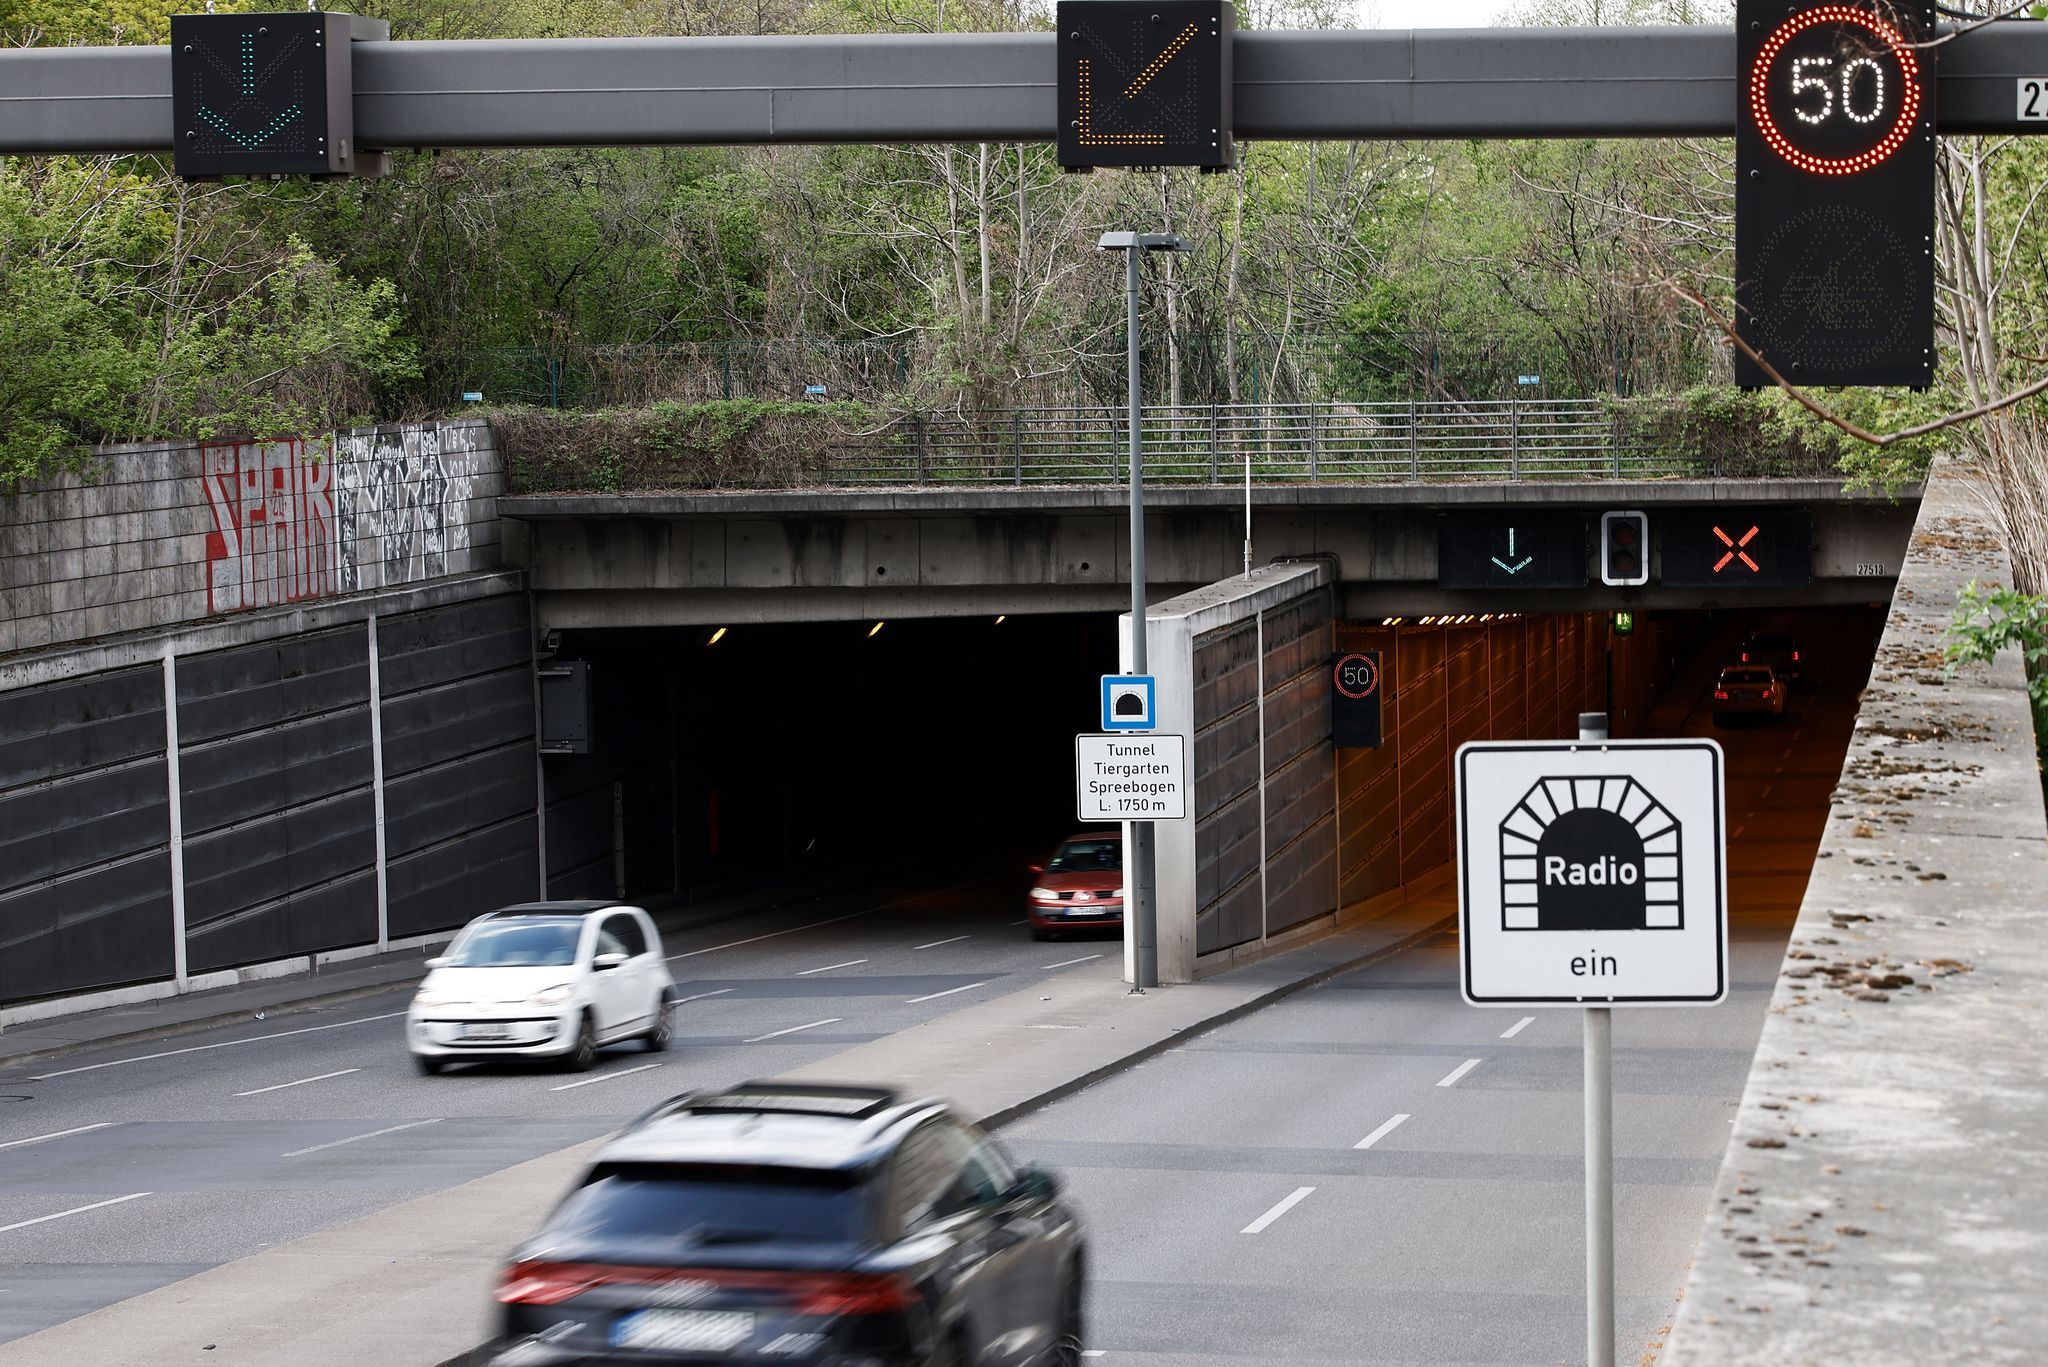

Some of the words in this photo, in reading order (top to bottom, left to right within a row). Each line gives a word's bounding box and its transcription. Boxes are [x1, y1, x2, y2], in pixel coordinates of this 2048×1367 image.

[1793, 57, 1884, 124] 50
[2024, 81, 2048, 117] 2
[1858, 564, 1884, 576] 27513
[1345, 667, 1369, 685] 50
[1106, 743, 1156, 757] Tunnel
[1093, 762, 1169, 778] Tiergarten
[1089, 781, 1176, 796] Spreebogen
[1099, 799, 1111, 812] L:
[1117, 799, 1149, 812] 1750
[1152, 801, 1166, 812] m
[1544, 855, 1638, 886] Radio
[1570, 948, 1617, 976] ein
